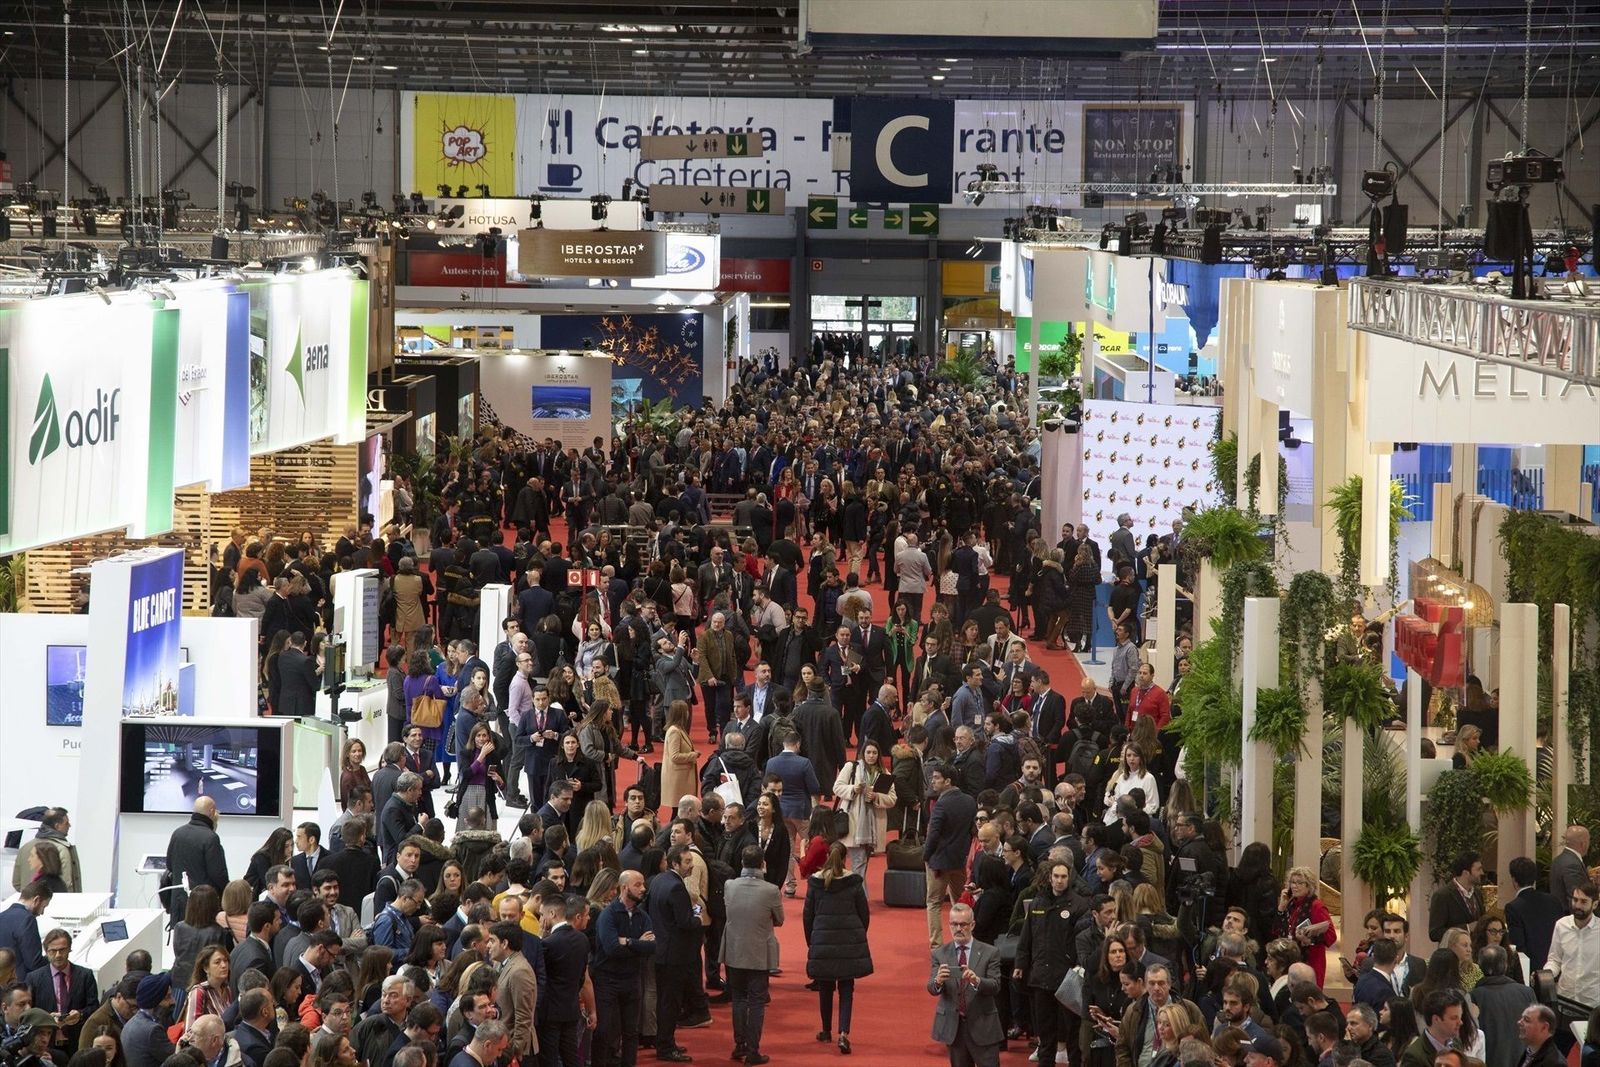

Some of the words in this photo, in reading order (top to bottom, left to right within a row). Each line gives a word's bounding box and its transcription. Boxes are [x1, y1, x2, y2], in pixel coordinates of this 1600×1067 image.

[448, 136, 471, 147] POP
[1133, 139, 1173, 151] STOP
[456, 146, 480, 157] ART
[875, 115, 930, 188] C
[468, 215, 517, 226] HOTUSA
[441, 265, 499, 276] Autosrvicio
[306, 344, 329, 371] aena
[65, 388, 121, 449] adif
[133, 595, 151, 634] BLUE
